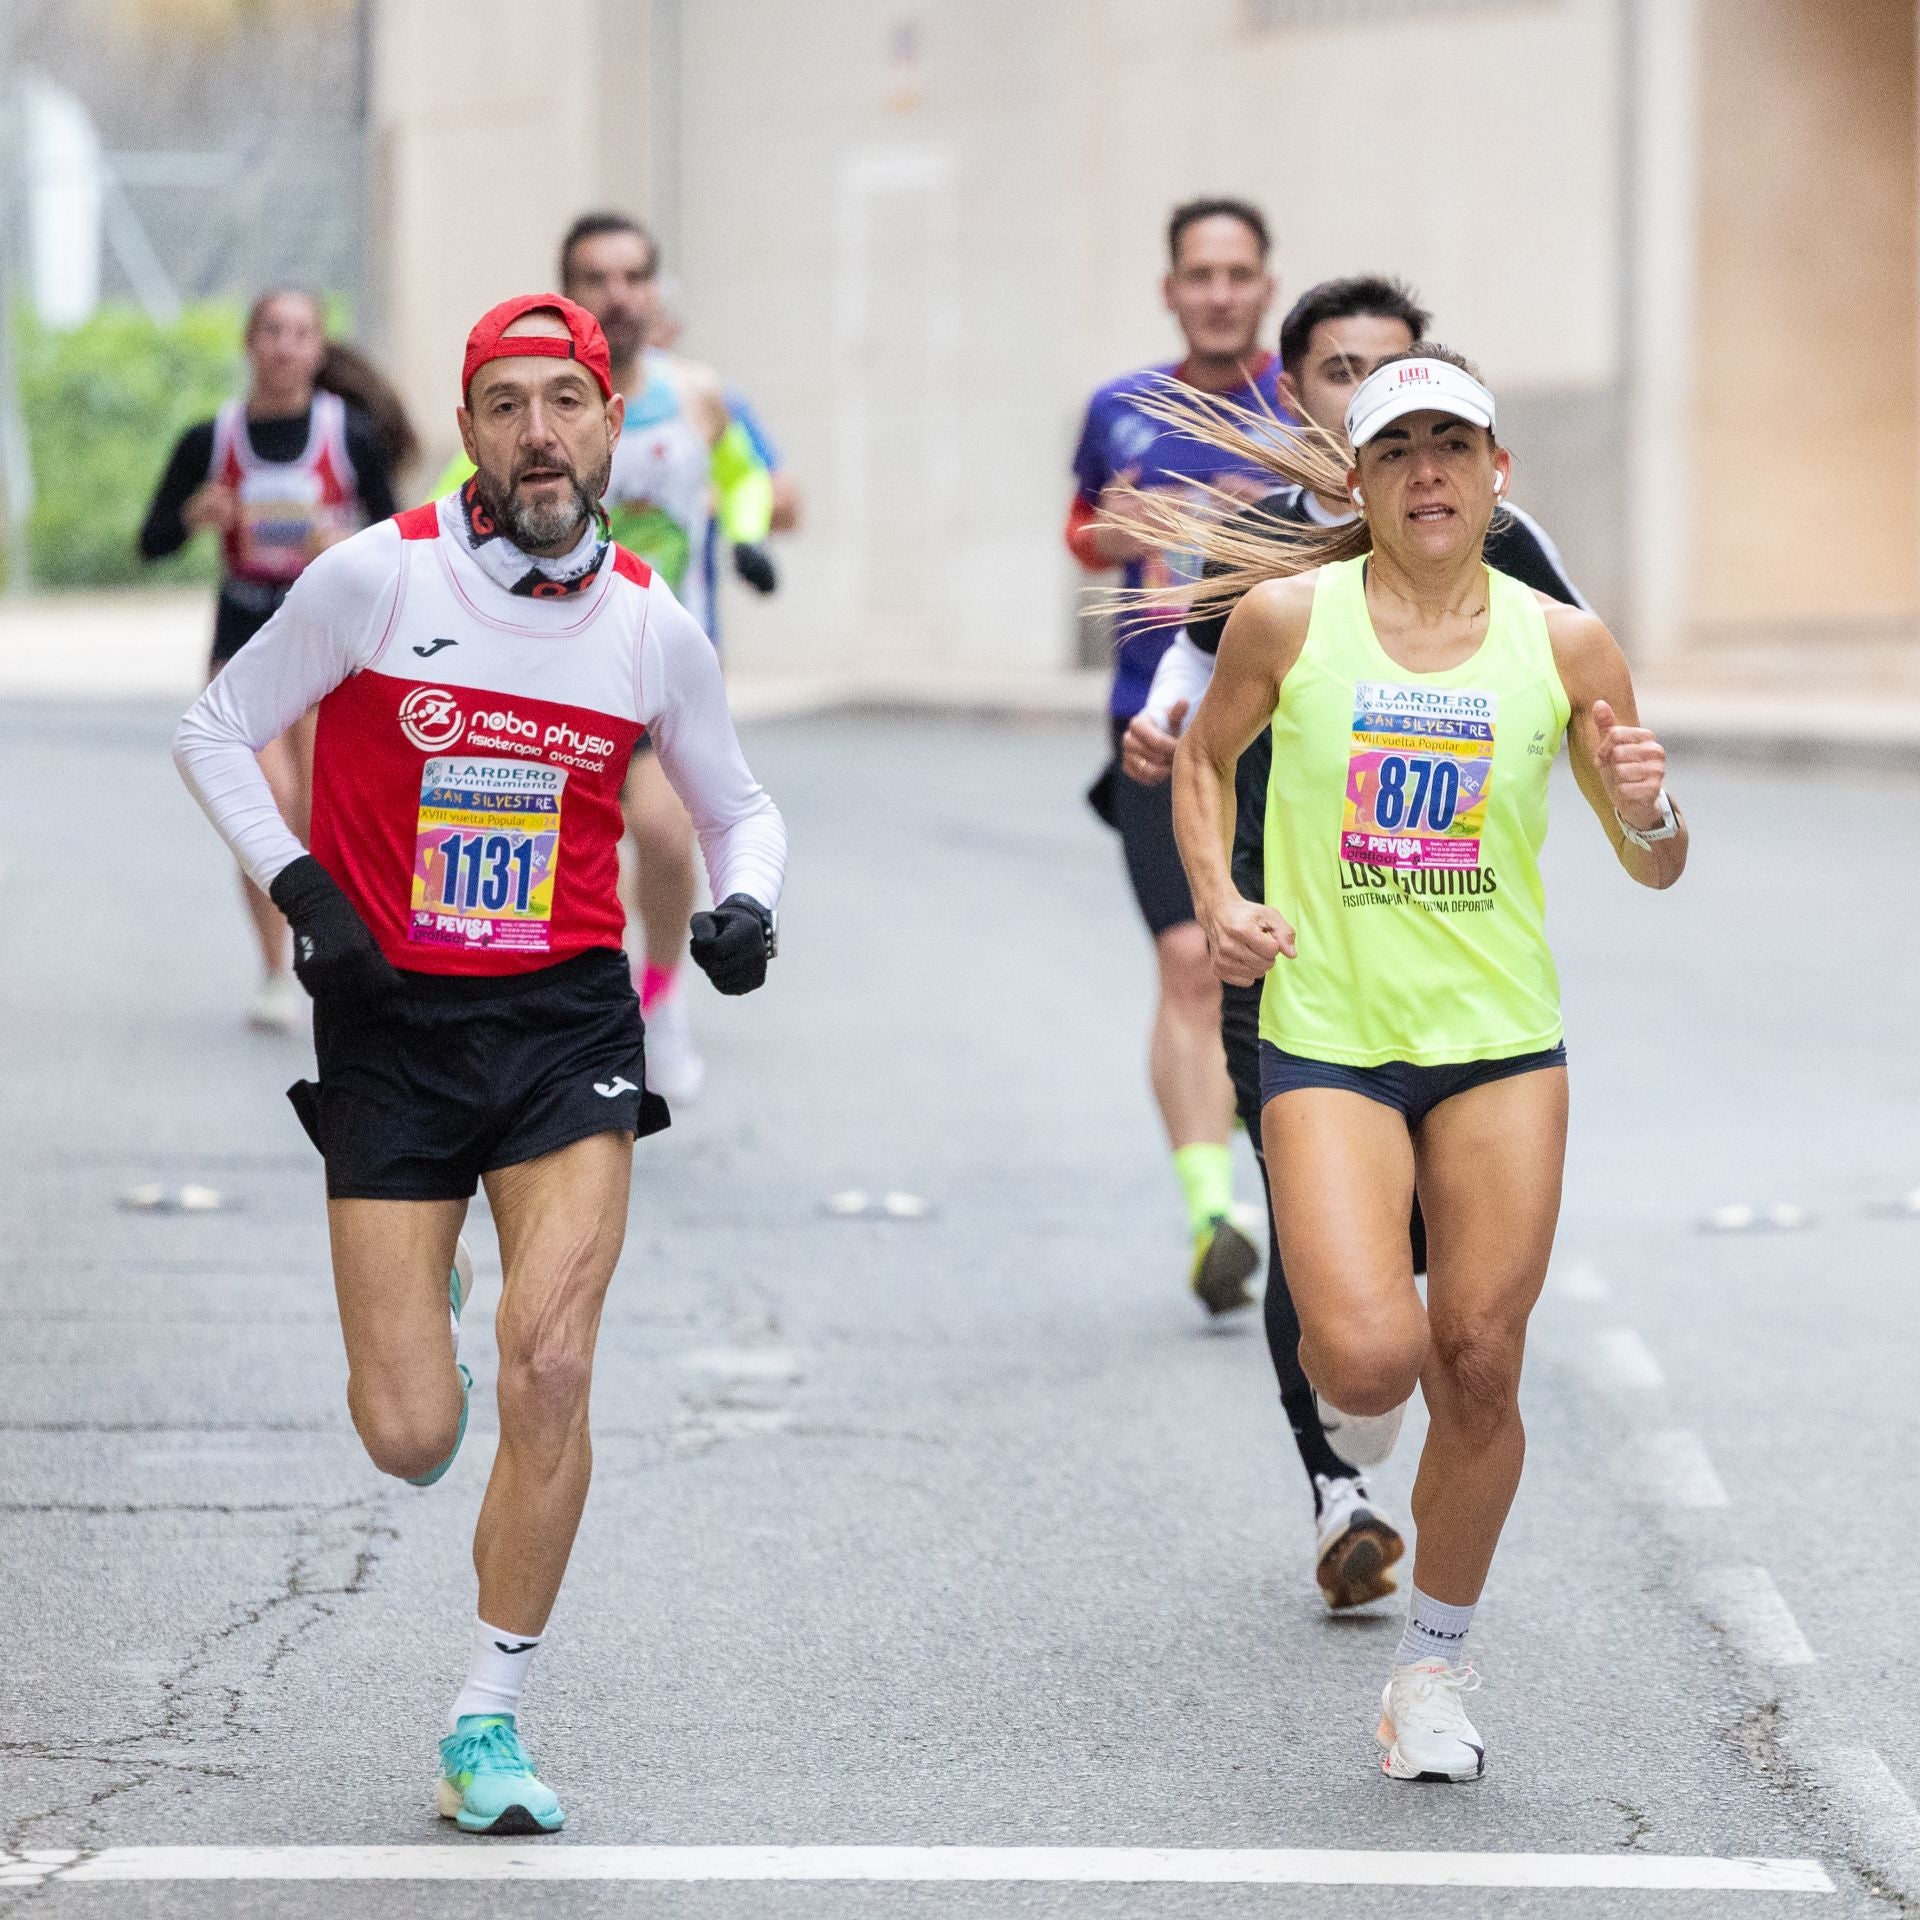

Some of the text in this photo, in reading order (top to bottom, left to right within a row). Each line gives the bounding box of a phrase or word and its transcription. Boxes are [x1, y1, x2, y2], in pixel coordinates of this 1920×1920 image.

[1375, 701, 1491, 717] ayuntamiento
[1379, 689, 1488, 708] LARDERO
[1364, 713, 1394, 728] SAN
[471, 710, 615, 756] noba physio
[1354, 732, 1491, 754] XVIII vuelta Popular 2024
[466, 731, 605, 773] fisioterapia avanzad
[443, 775, 558, 790] ayuntamiento
[448, 764, 557, 782] LARDERO
[432, 788, 462, 804] SAN
[1375, 755, 1459, 832] 870
[421, 809, 557, 827] XVIII vuelta Popular 2024
[1367, 836, 1422, 859] PEVISA
[440, 832, 534, 911] 1131
[1342, 891, 1401, 908] FISIOTERAPIA
[1402, 894, 1410, 906] Y
[1452, 898, 1495, 913] DEPORTIVA
[436, 914, 493, 940] PEVISA
